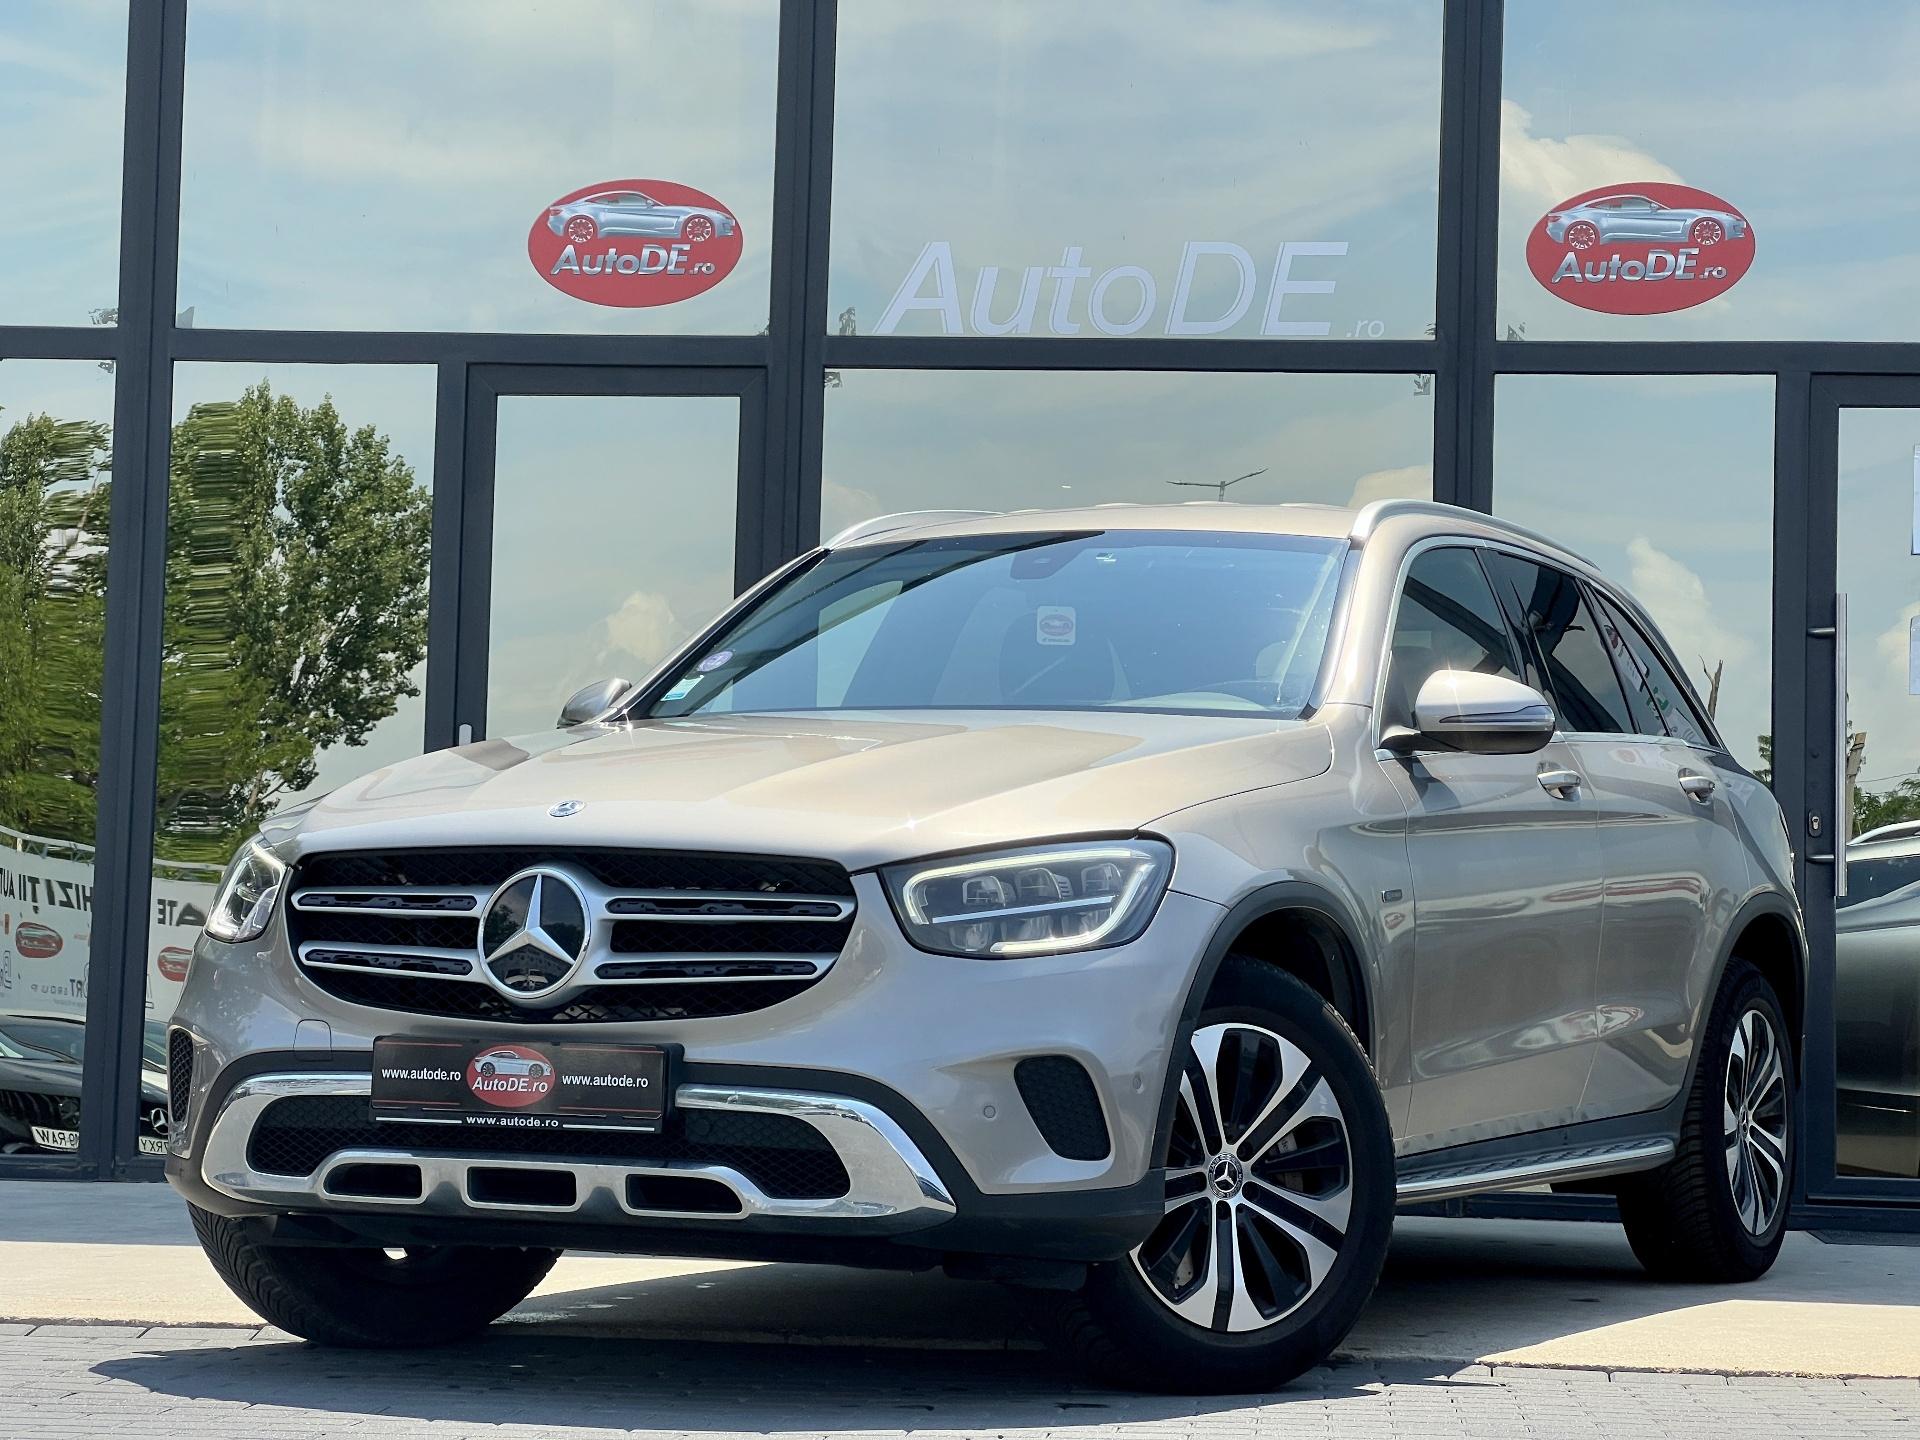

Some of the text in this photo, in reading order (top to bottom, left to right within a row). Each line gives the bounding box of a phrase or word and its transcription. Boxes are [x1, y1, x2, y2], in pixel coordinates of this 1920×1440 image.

[381, 1066, 461, 1081] www.autode.ro
[561, 1073, 649, 1088] www.autode.ro
[472, 1077, 548, 1093] AutoDE.ro
[466, 1115, 559, 1128] www.autode.ro
